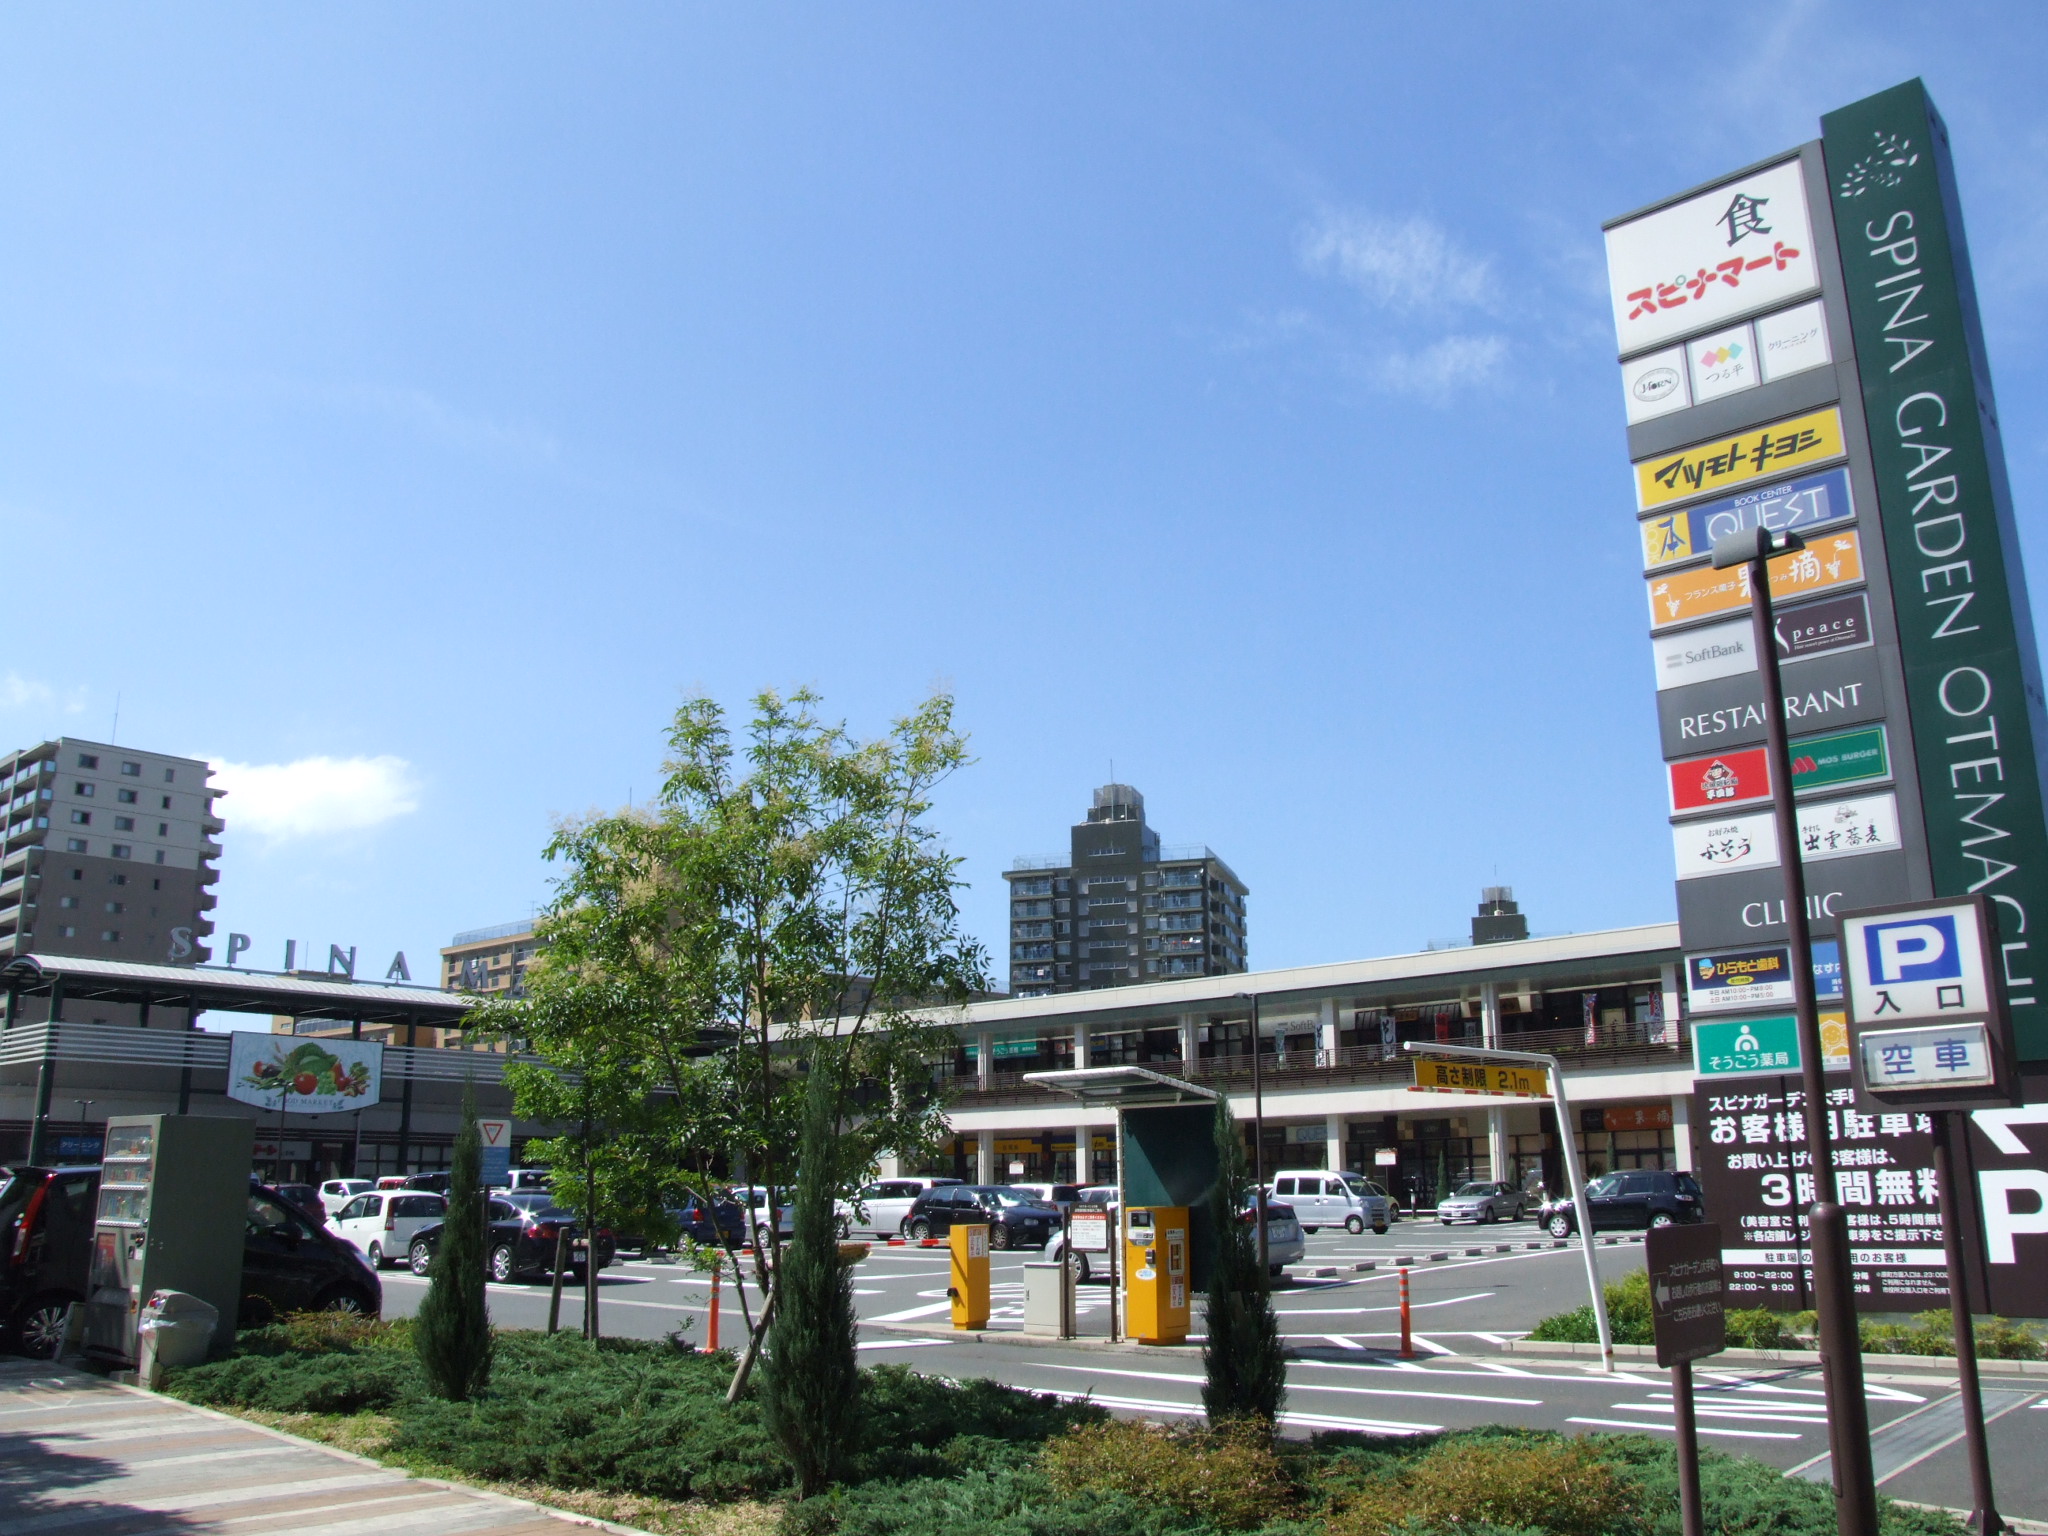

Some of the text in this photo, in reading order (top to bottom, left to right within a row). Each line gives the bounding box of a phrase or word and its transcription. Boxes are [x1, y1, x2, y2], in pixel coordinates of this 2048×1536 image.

[1716, 193, 1772, 247] 食
[1627, 241, 1799, 320] スピナマート
[1866, 210, 1935, 374] SPINA
[1654, 428, 1823, 490] マツモトキヨシ
[1707, 487, 1824, 542] QUEST
[1734, 485, 1793, 508] BOOK CENTER
[1896, 392, 1980, 641] GARDEN
[1792, 616, 1855, 643] peace
[1685, 642, 1745, 665] SoftBank
[1817, 748, 1879, 766] MOS BURGER
[168, 925, 412, 981] SPINA
[1716, 956, 1780, 976] ひらもと歯科
[1877, 924, 1945, 981] P
[1435, 1064, 1530, 1090] 高さ制限 2.1m
[1709, 1051, 1789, 1071] そうごう薬局
[1882, 1038, 1970, 1076] 空車
